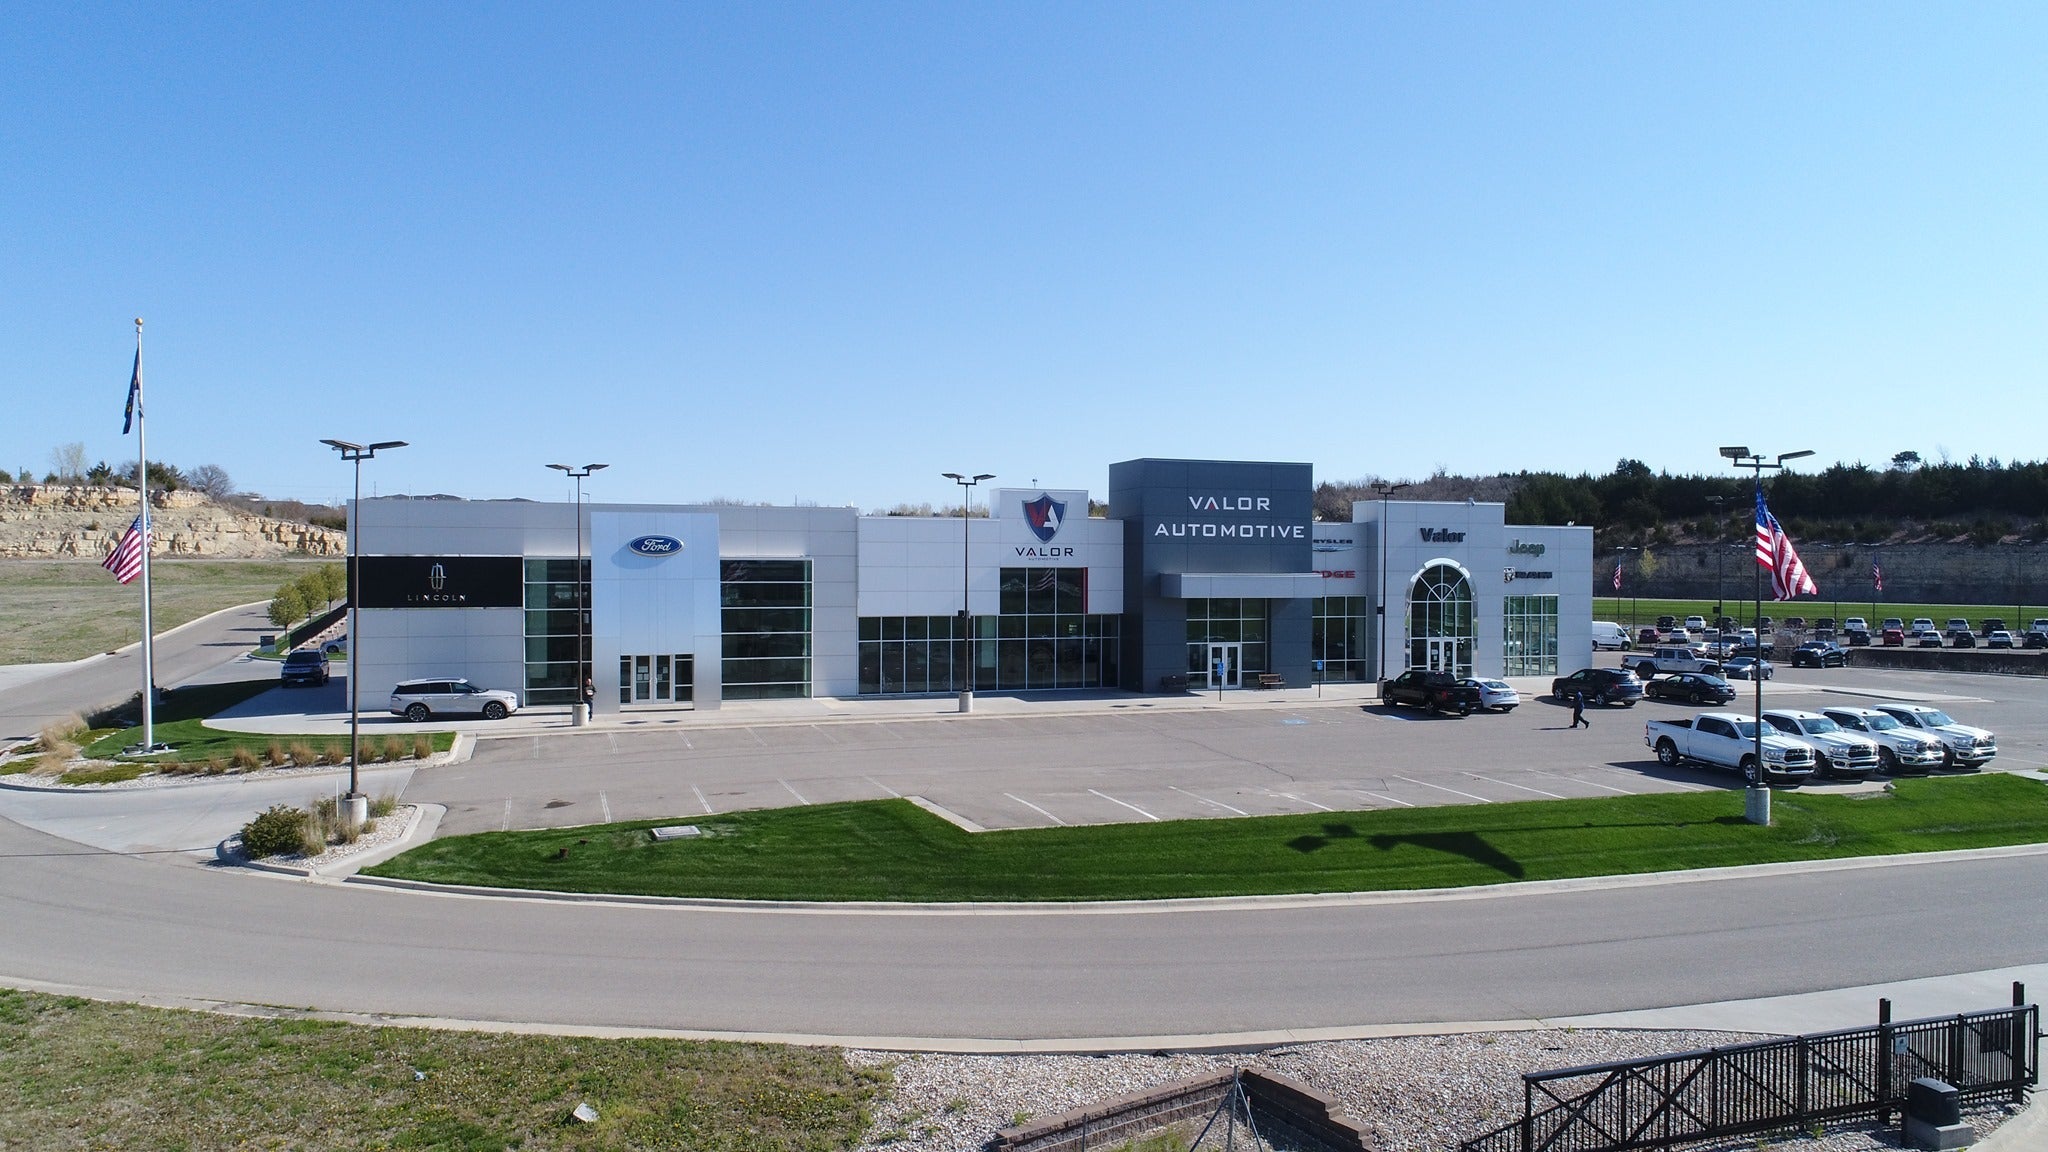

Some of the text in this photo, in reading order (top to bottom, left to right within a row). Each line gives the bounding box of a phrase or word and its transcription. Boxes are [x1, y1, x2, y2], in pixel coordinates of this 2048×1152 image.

[1188, 496, 1270, 511] VALOR
[1154, 523, 1305, 538] AUTOMOTIVE
[1419, 527, 1466, 543] Valor
[641, 538, 672, 551] Ford
[1508, 538, 1546, 558] Jeep
[1015, 547, 1074, 557] VALOR
[1312, 570, 1356, 579] DGE
[407, 594, 466, 602] LINCOLN
